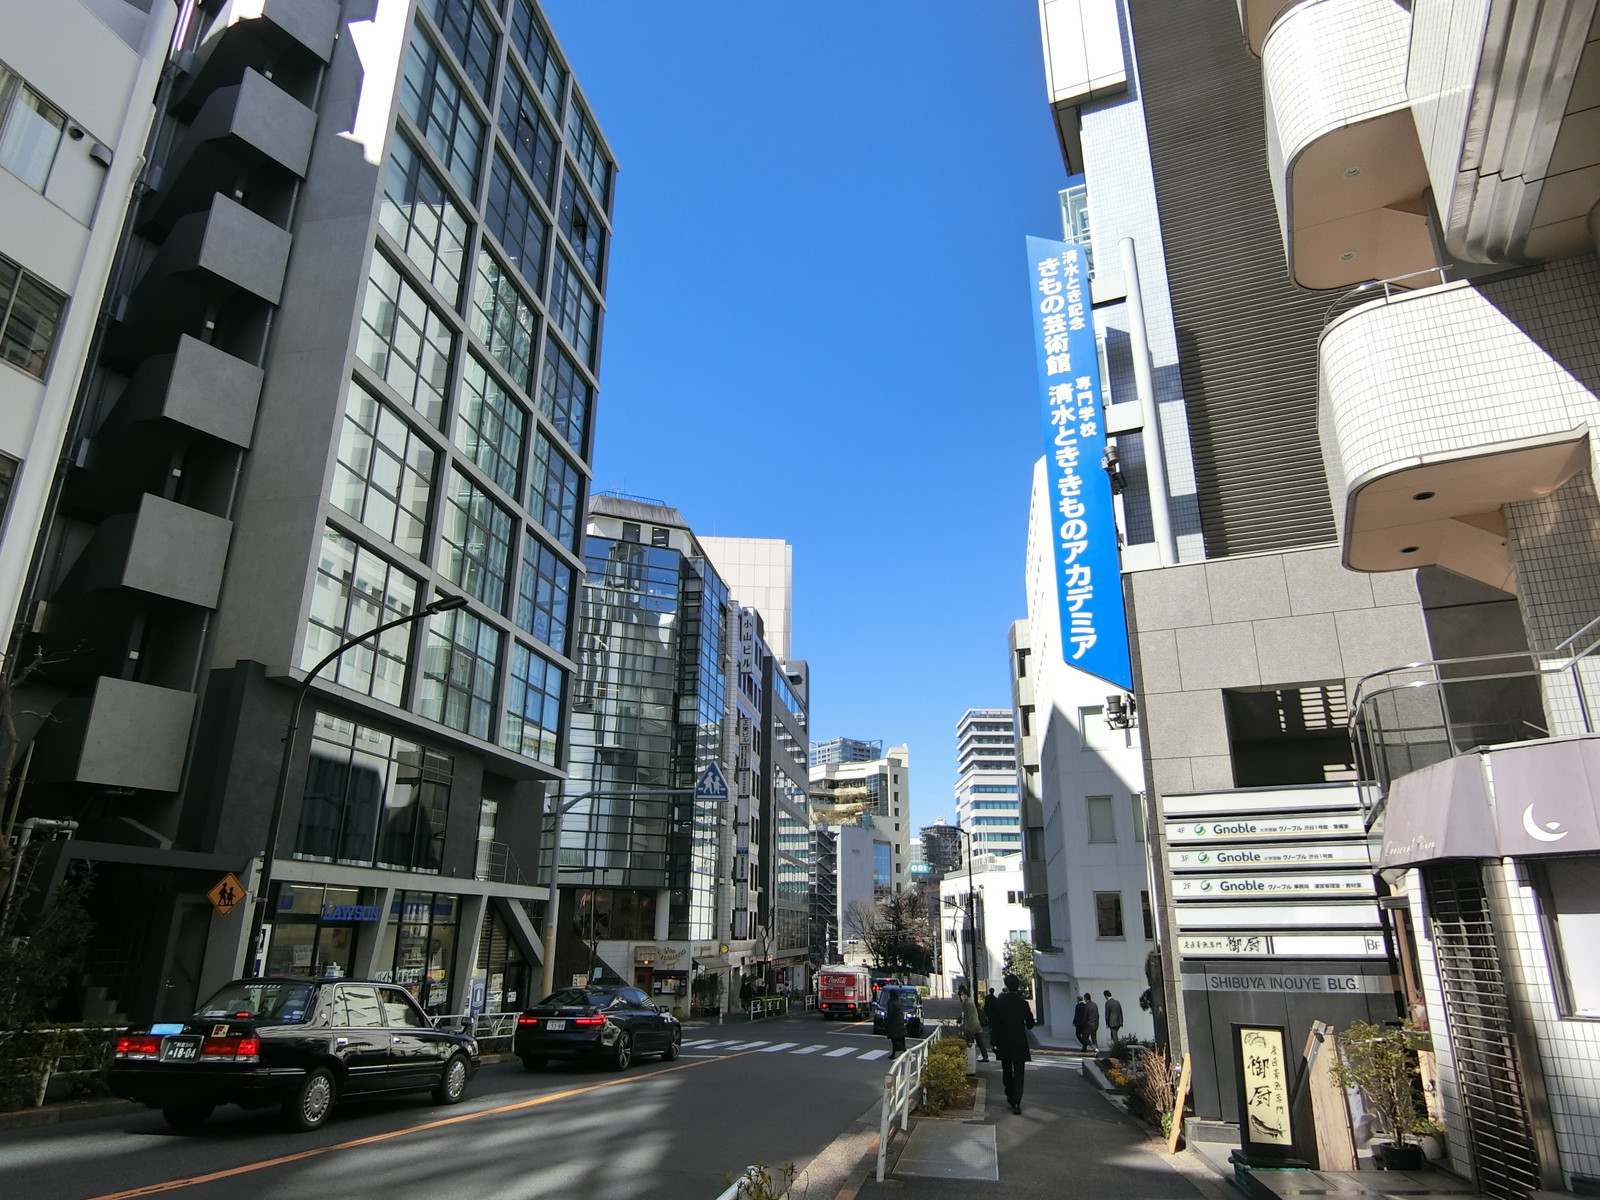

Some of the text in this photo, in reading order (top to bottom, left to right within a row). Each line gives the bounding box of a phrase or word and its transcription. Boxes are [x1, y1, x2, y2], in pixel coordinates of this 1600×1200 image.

[1062, 249, 1085, 331] 清水とき記念
[1038, 257, 1072, 376] きもの芸術館
[1075, 376, 1098, 438] 専門学校
[1048, 382, 1098, 660] 清水とき・きものアカデミア
[1213, 823, 1257, 835] Gnoble
[1385, 837, 1416, 857] Crescent
[1217, 851, 1261, 863] Gnoble
[1183, 882, 1191, 890] 2F
[1220, 880, 1265, 892] Gnoble
[322, 904, 380, 921] LAWSON
[1366, 939, 1380, 950] BF
[1211, 976, 1360, 990] SHIBUYA INOUYE BLG.
